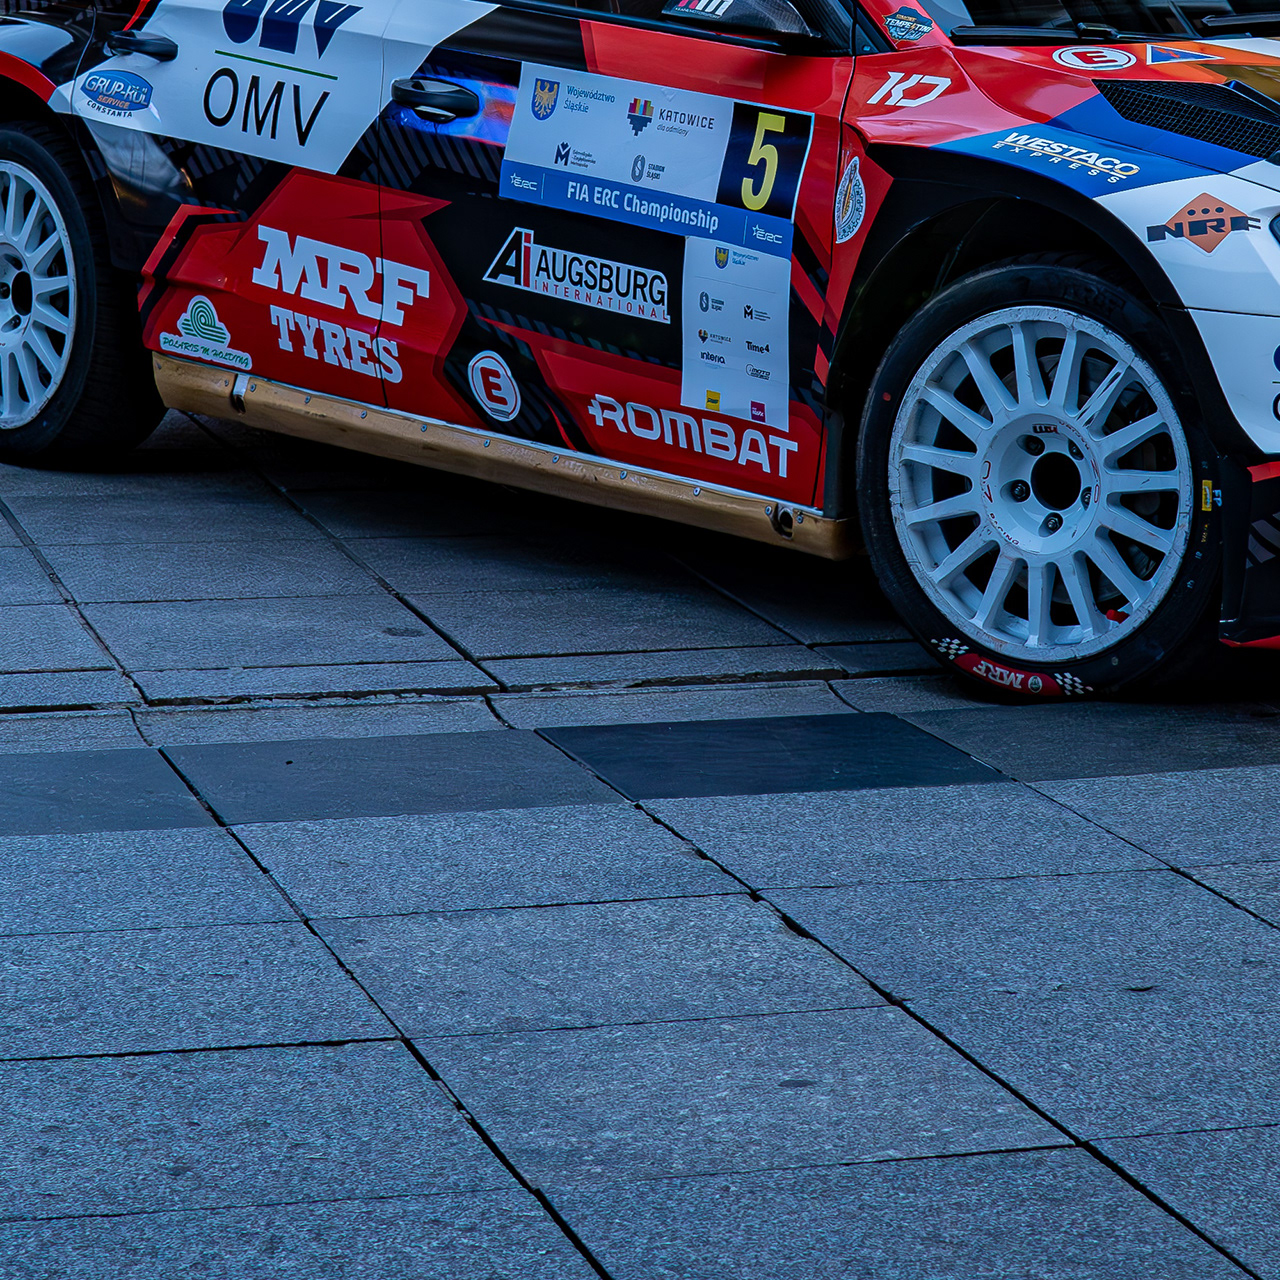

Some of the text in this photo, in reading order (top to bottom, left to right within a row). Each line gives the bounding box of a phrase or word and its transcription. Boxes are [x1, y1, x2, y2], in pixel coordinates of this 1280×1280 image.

[97, 94, 131, 109] SERVICE
[203, 67, 330, 148] OMV
[563, 100, 590, 115] Śląskie
[566, 85, 616, 105] Województwo
[658, 107, 716, 131] KATOWICE
[740, 111, 787, 211] 5
[992, 142, 1120, 184] EXPRESS
[1003, 132, 1141, 181] WESTACO
[567, 181, 719, 233] FIA ERC Championship
[1146, 214, 1261, 242] NRF
[251, 224, 430, 327] MRF
[535, 248, 667, 307] AUGSBURG
[534, 279, 669, 322] INTERNATIONAL
[270, 304, 403, 384] TYRES
[745, 340, 770, 354] Time4
[586, 393, 798, 479] ROMBAT
[973, 660, 1025, 689] MRF
